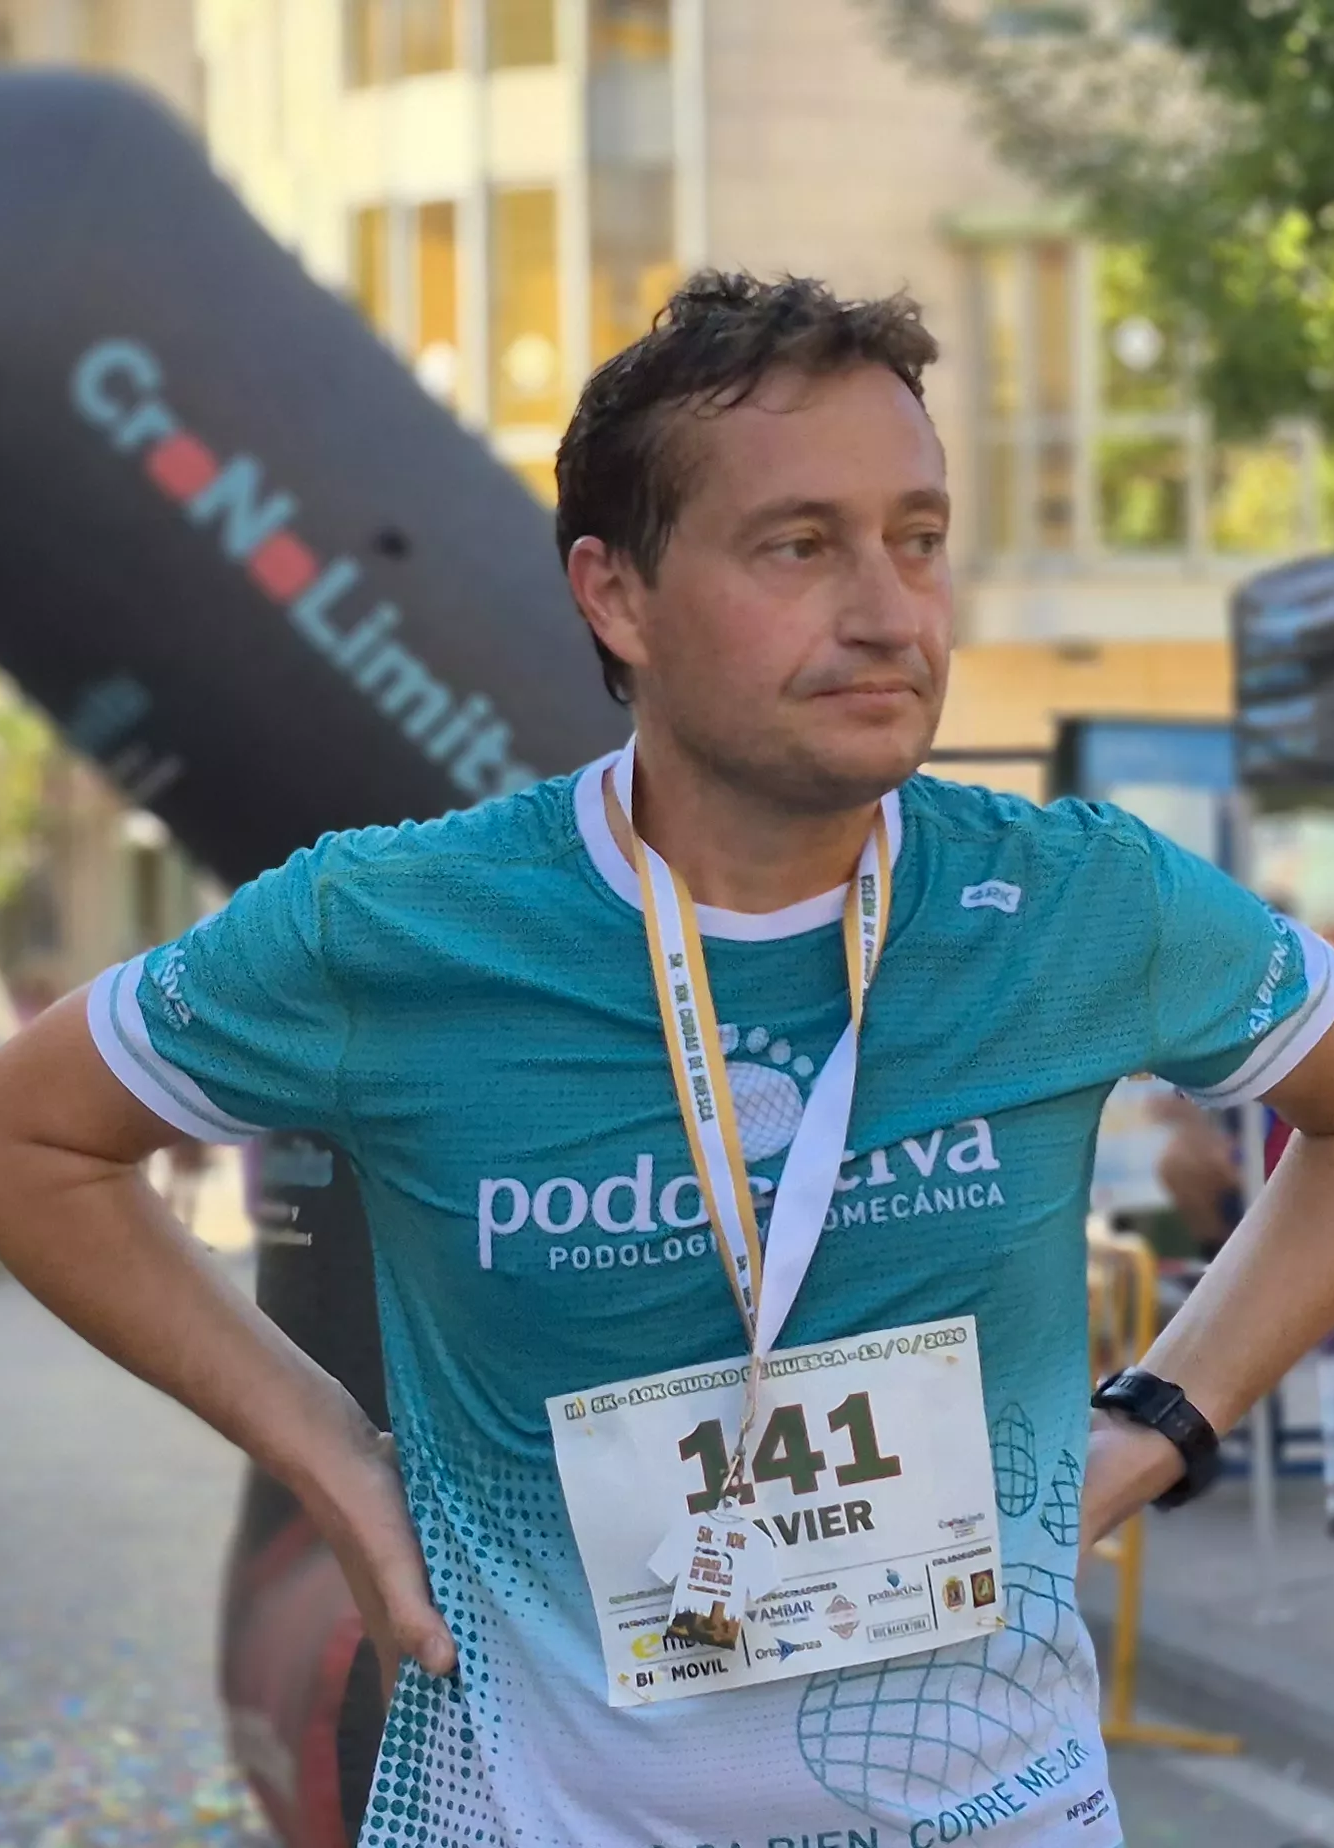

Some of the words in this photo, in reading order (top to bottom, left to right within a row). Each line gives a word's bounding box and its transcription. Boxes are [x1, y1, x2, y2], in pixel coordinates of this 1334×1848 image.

[549, 1232, 720, 1271] PODOLOGI
[821, 1180, 1005, 1232] OMECÁNICA
[668, 1368, 740, 1396] CIUDAD
[769, 1348, 848, 1378] HUESCA
[678, 1391, 903, 1515] 141
[753, 1499, 875, 1548] VIER
[760, 1600, 815, 1621] AMBAR
[671, 1657, 729, 1682] MOVIL
[909, 1781, 1028, 1848] CORRE
